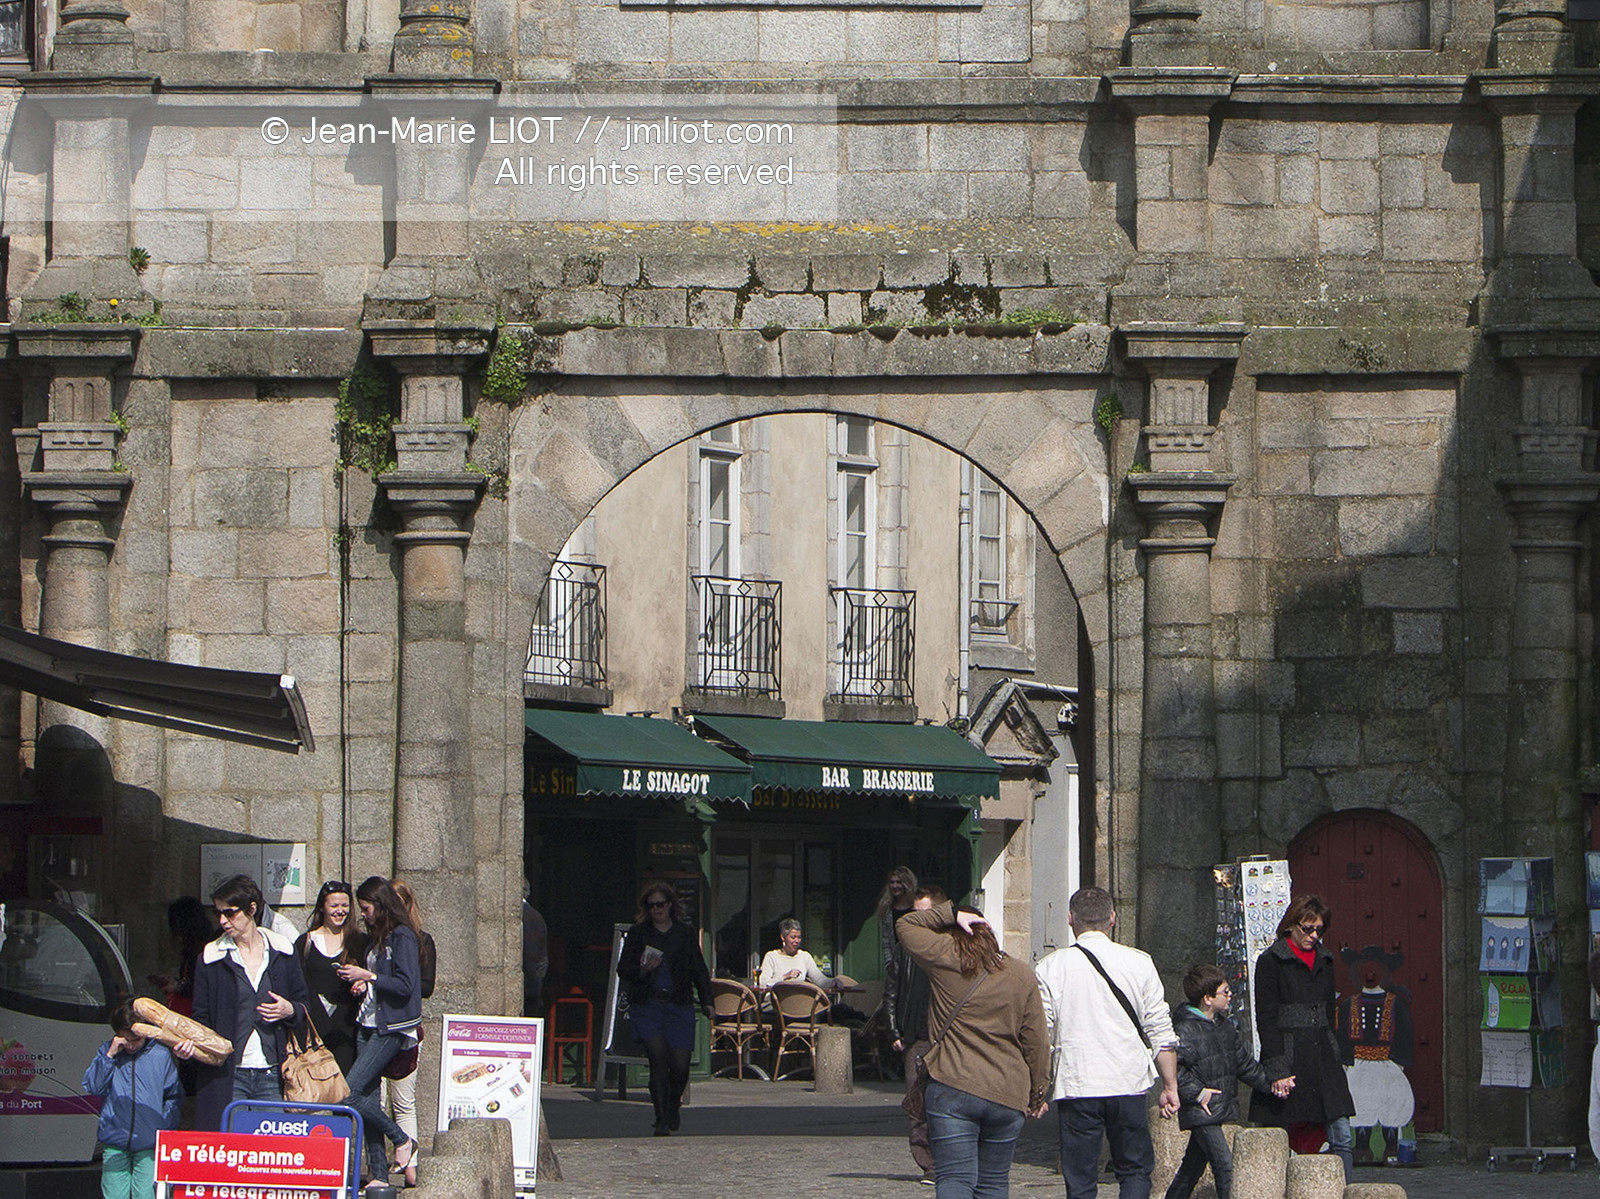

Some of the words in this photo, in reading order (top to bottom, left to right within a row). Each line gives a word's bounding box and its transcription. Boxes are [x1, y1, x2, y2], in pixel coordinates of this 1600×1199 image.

[622, 769, 641, 791] LE
[646, 770, 710, 795] SINAGOT
[822, 766, 850, 788] BAR
[862, 769, 935, 792] BRASSERIE
[0, 1066, 16, 1075] ion
[22, 1066, 56, 1075] maison
[6, 1100, 19, 1108] du
[21, 1099, 42, 1108] Port
[260, 1120, 309, 1137] ouest
[160, 1144, 182, 1162] Le
[187, 1144, 305, 1168] Télégramme
[237, 1165, 270, 1174] Découvrez
[282, 1167, 312, 1175] nouvelles
[312, 1167, 341, 1176] formules
